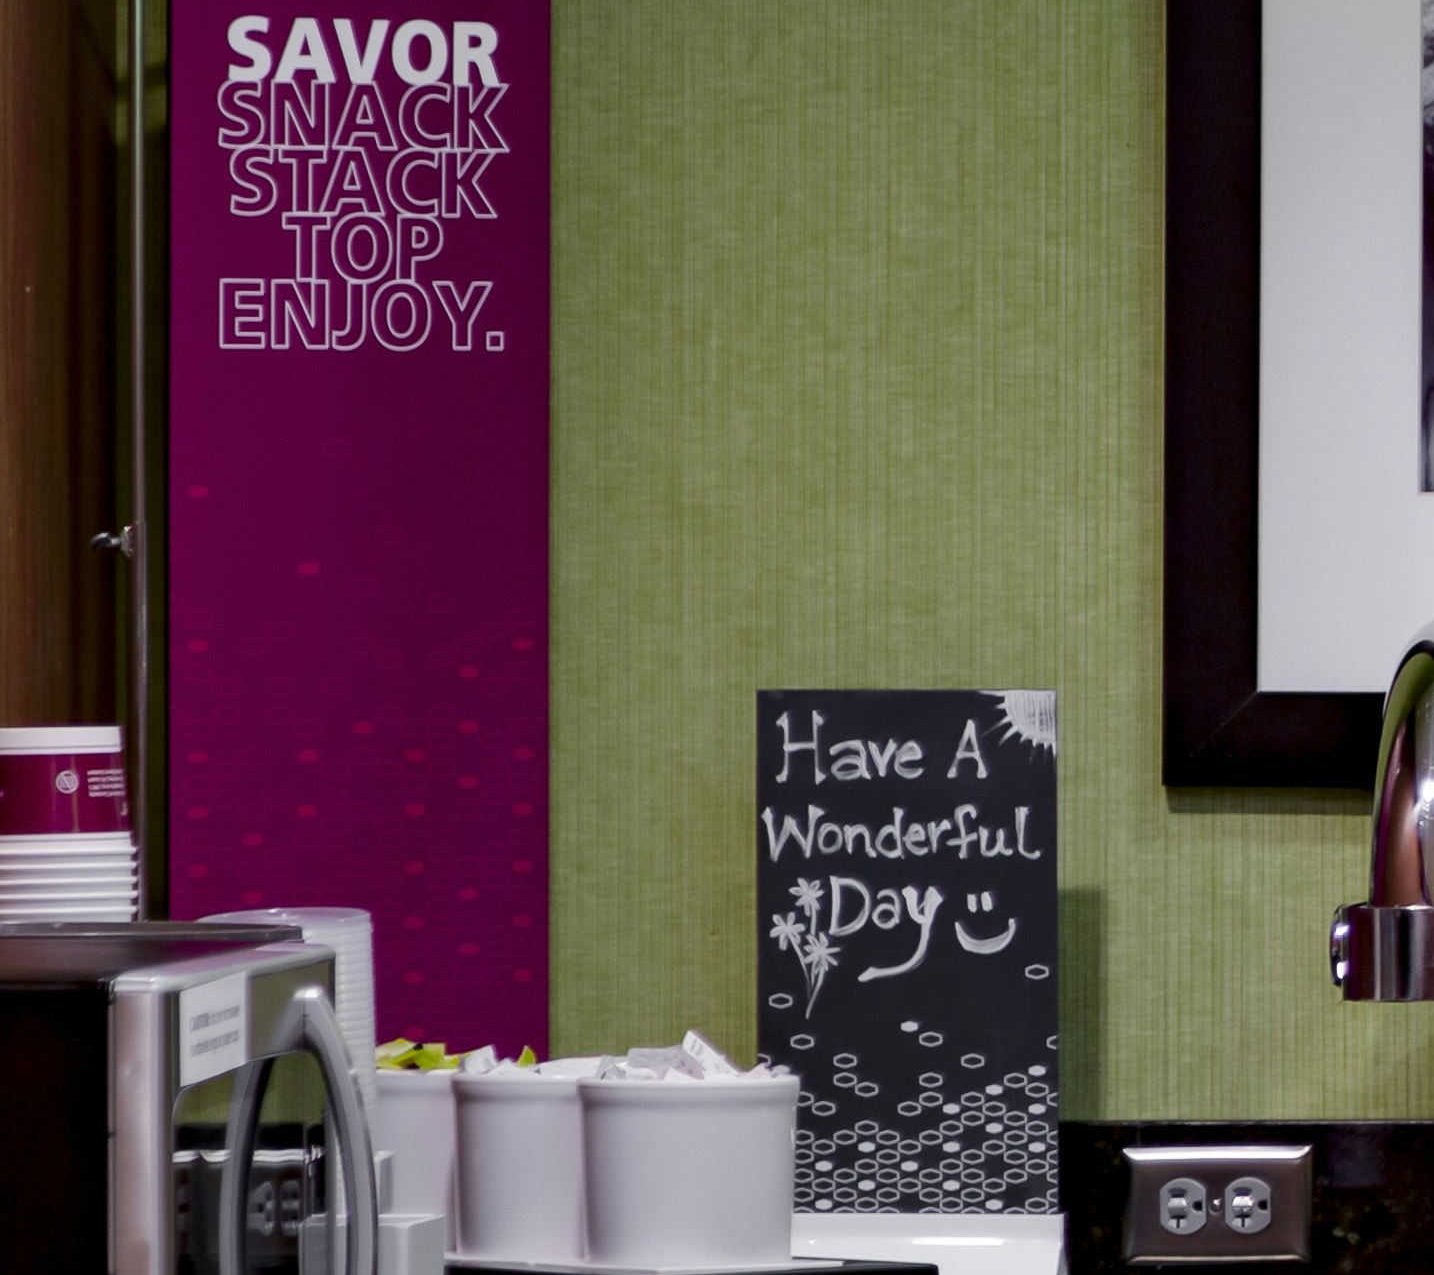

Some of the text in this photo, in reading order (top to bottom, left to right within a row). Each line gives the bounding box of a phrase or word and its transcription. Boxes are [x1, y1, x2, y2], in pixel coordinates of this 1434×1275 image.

[226, 15, 500, 87] SAVOR
[216, 79, 511, 154] SNACK
[229, 145, 499, 220] STACK
[281, 211, 445, 285] TOP
[218, 277, 505, 352] ENJOY.
[775, 710, 989, 785] Have A
[760, 803, 1042, 863] Wonderful
[828, 875, 945, 983] Day
